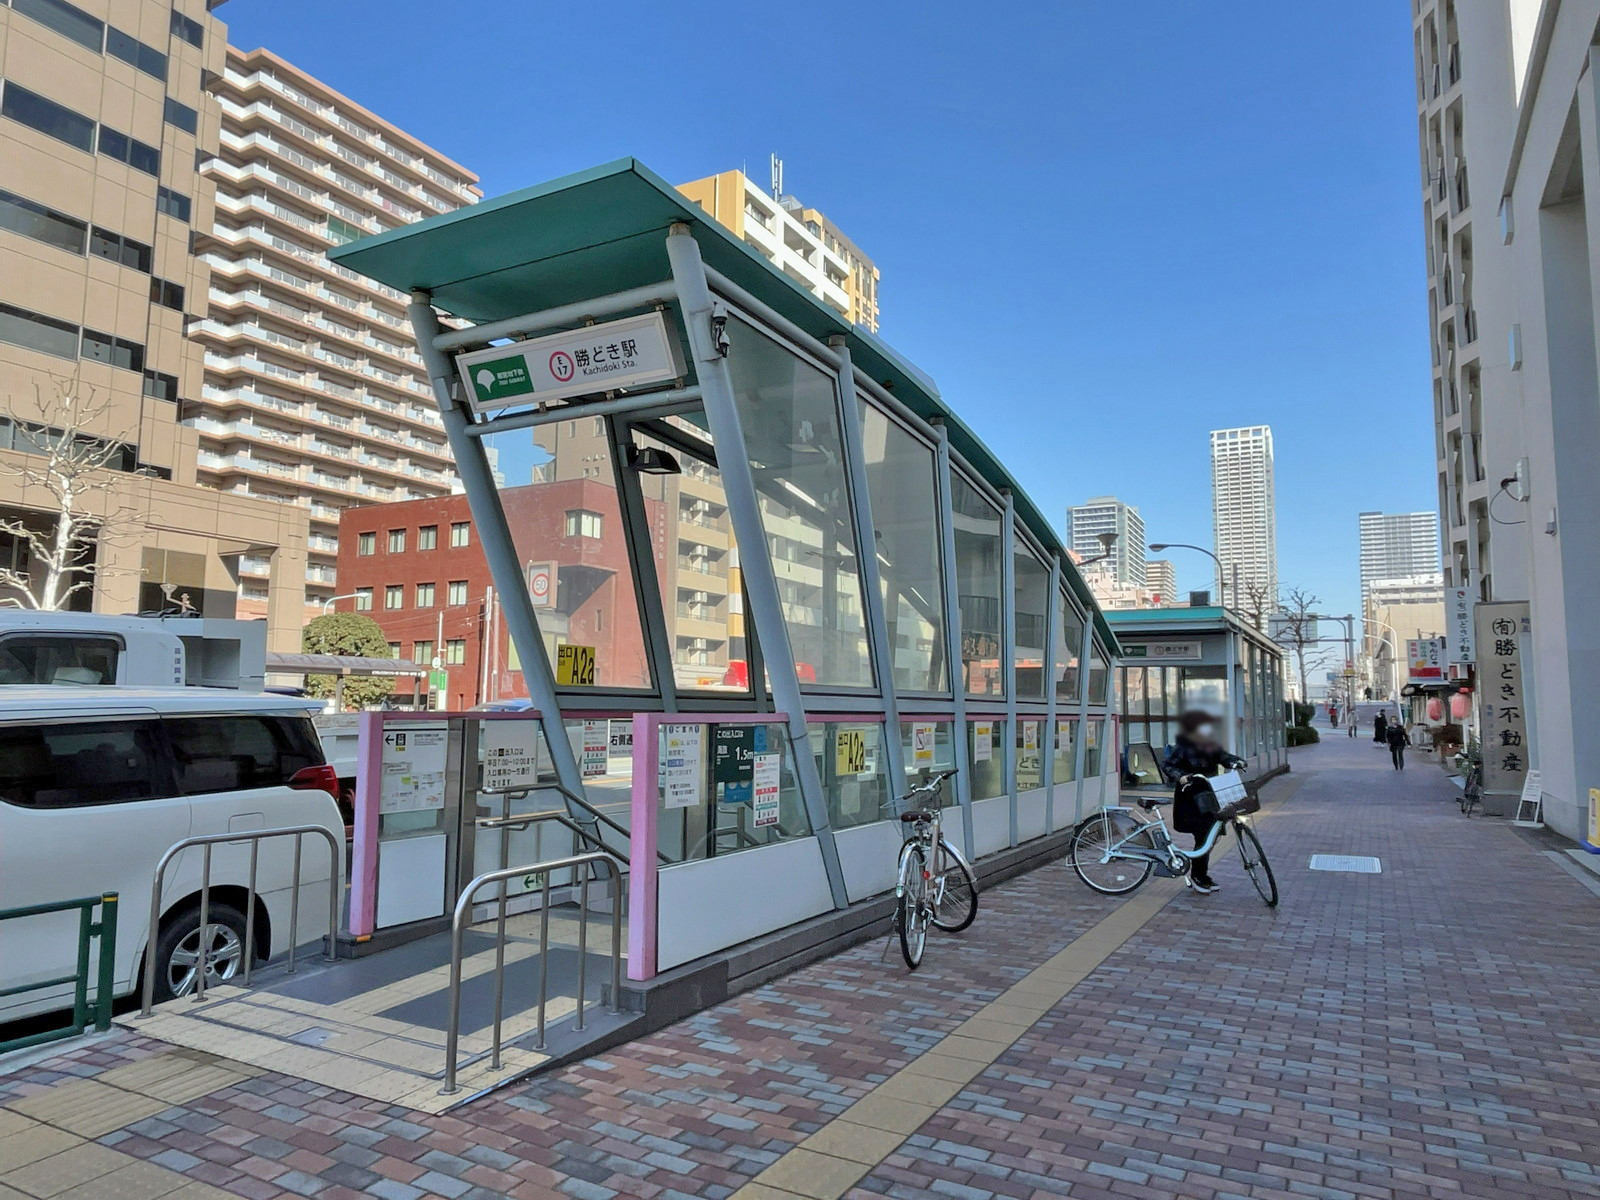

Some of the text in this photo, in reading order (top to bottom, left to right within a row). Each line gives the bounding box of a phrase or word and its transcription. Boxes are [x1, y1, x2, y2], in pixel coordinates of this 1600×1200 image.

[557, 356, 563, 365] E
[574, 339, 638, 367] 勝どき駅
[557, 366, 568, 376] 17
[582, 359, 638, 376] Kachidoki Sta.
[535, 579, 546, 590] 50
[571, 647, 595, 685] A2a
[848, 732, 865, 772] A2a
